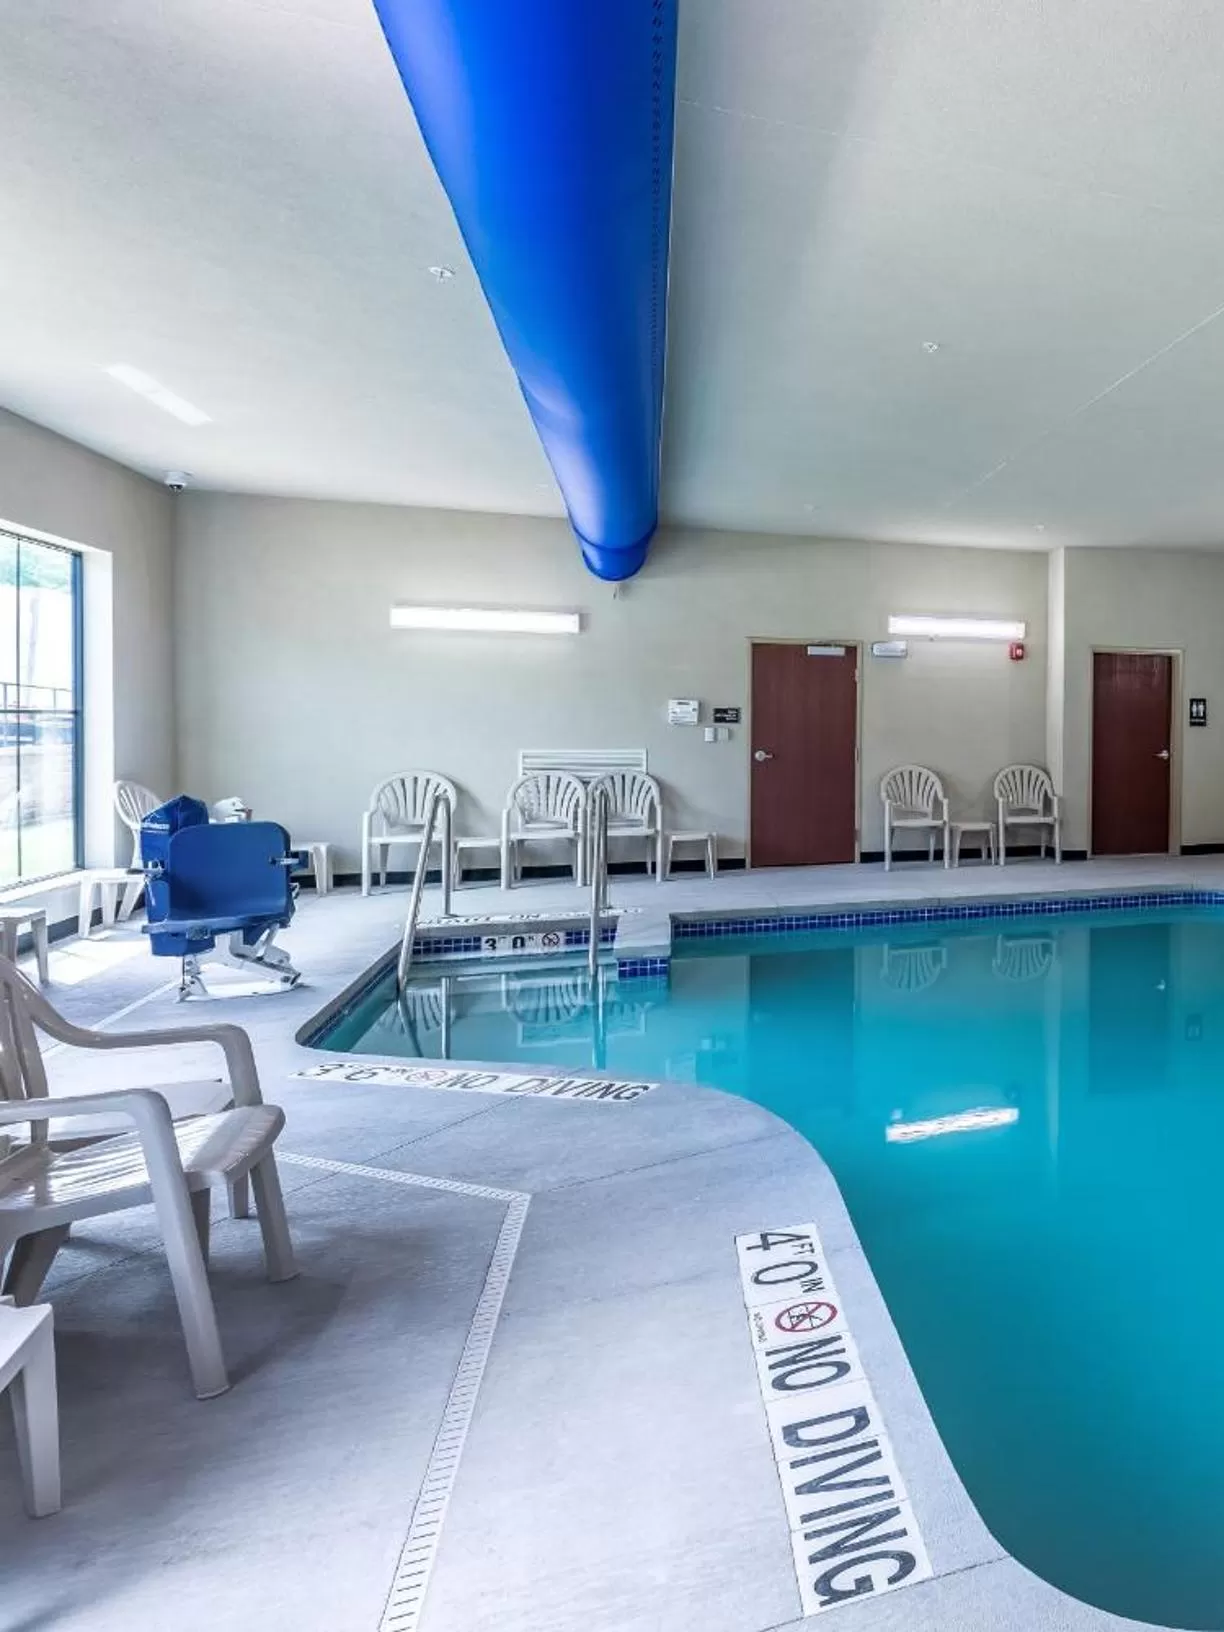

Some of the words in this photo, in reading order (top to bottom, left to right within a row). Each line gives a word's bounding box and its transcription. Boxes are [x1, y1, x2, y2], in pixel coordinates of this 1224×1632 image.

[433, 1071, 499, 1090] NO
[503, 1076, 650, 1101] DIVING
[765, 1334, 852, 1392] NO
[781, 1405, 917, 1608] DIVING
